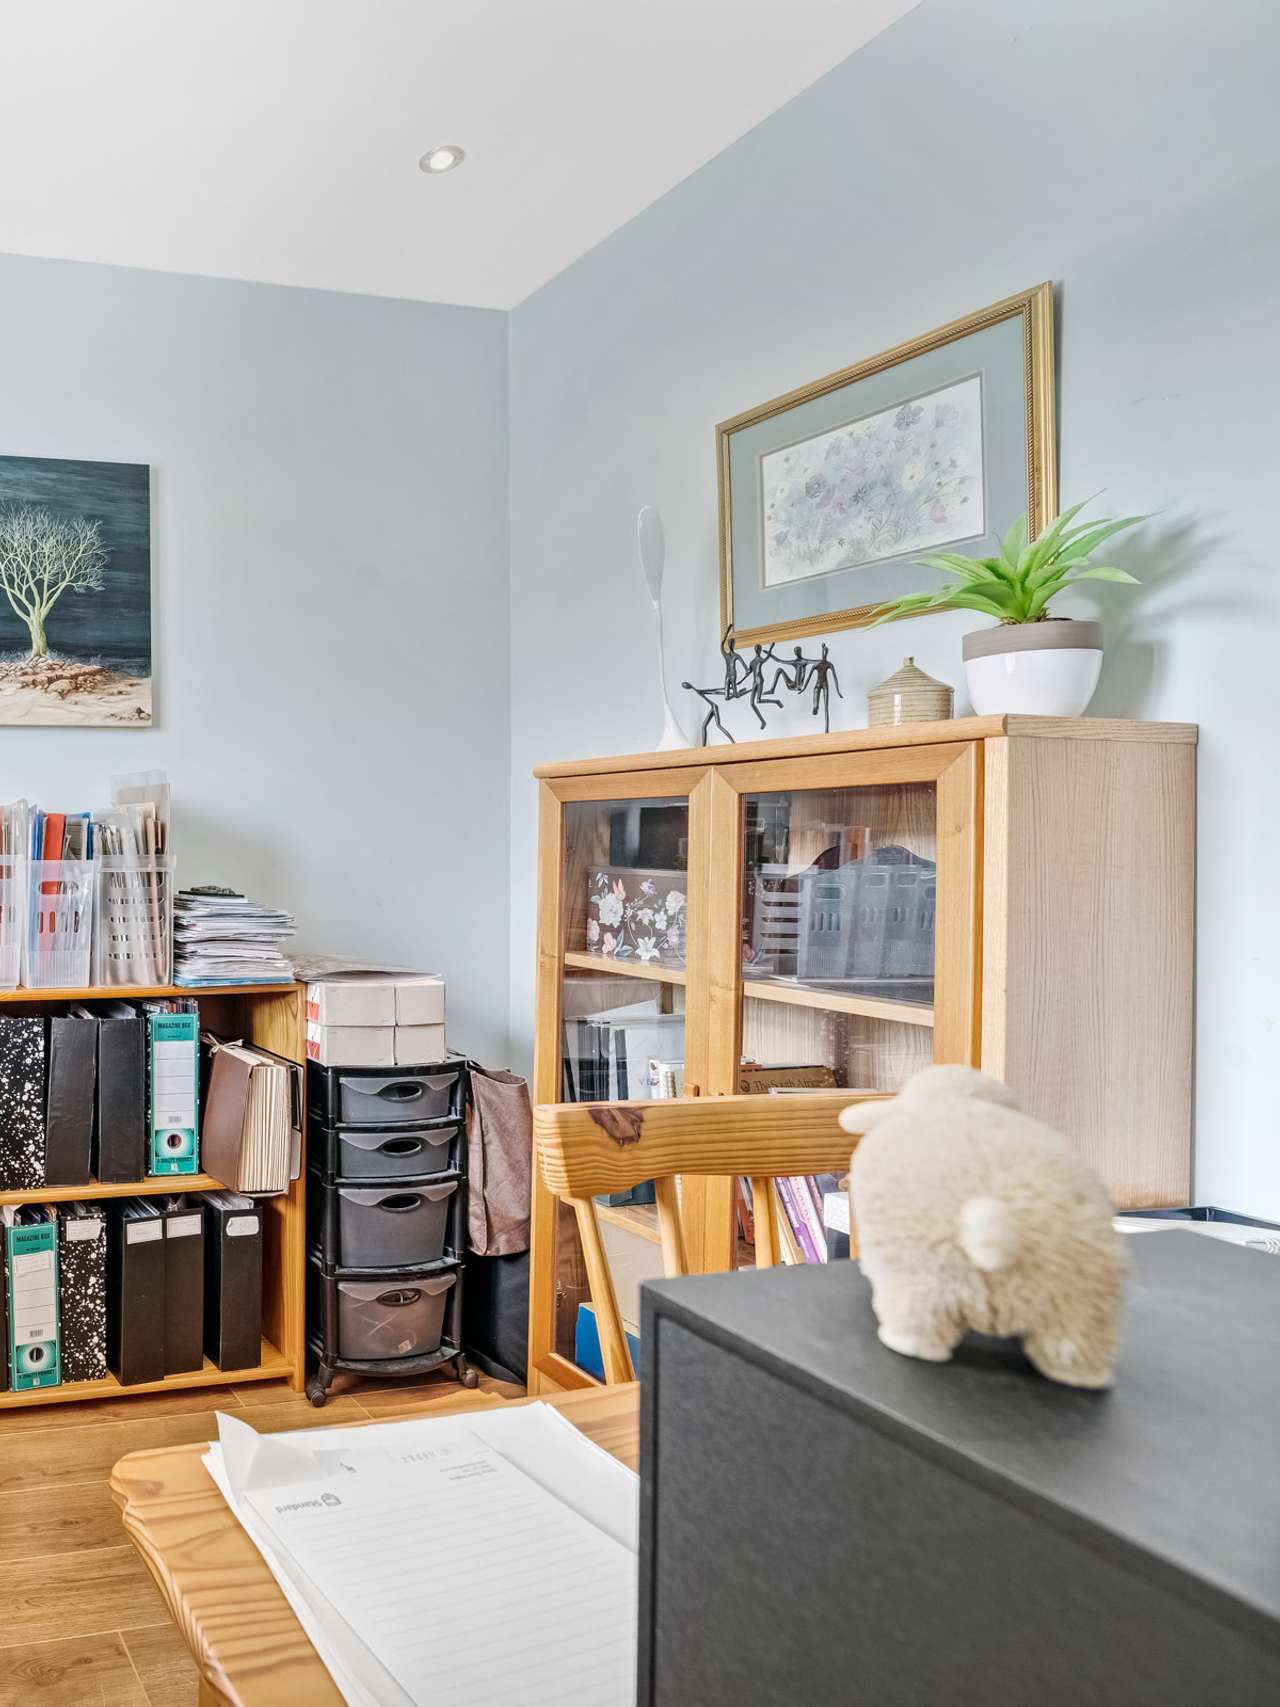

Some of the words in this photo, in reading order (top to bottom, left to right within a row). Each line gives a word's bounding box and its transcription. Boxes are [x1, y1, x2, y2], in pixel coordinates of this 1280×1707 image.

[158, 1021, 181, 1029] MAGAZINE
[181, 1021, 192, 1029] BOX
[16, 1233, 40, 1243] MAGAZINE
[40, 1232, 51, 1241] BOX
[274, 1498, 323, 1514] Standard
